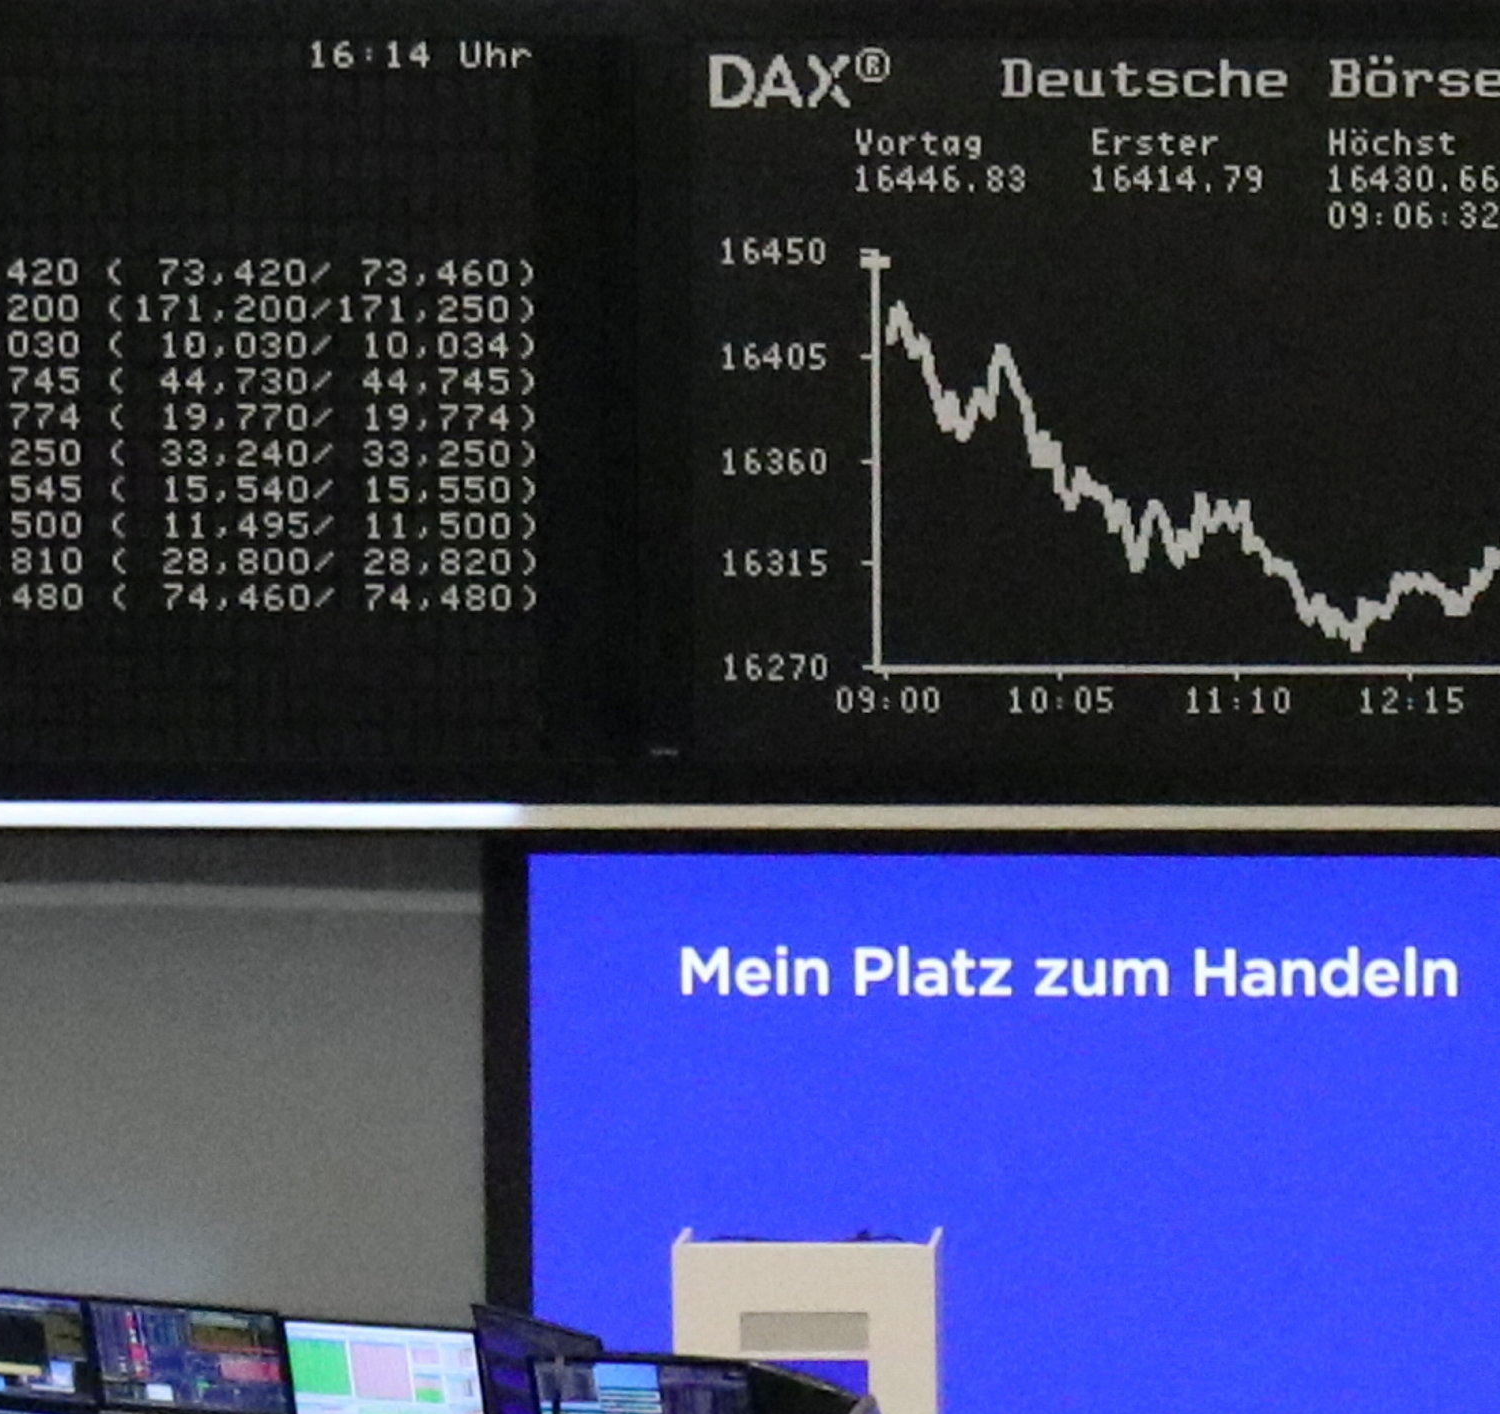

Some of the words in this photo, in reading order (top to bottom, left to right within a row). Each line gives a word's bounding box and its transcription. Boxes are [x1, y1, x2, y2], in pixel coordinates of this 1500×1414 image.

[310, 39, 431, 69] 16:14
[459, 40, 532, 69] Uhr
[1001, 58, 1288, 98] Deutsche
[855, 128, 982, 160] Vortag
[1091, 127, 1219, 156] Erster
[1328, 128, 1455, 157] Höchst
[856, 164, 1026, 193] 16446.83
[1092, 164, 1263, 193] 16414.79
[1329, 164, 1499, 193] 16430.66
[1328, 200, 1499, 230] 09:06:32
[721, 236, 826, 265] 16450
[722, 342, 827, 371] 16405
[723, 447, 827, 476] 16360
[724, 548, 827, 577] 16315
[724, 653, 828, 682] 16270
[836, 686, 940, 714] 09:00
[1009, 685, 1113, 714] 10:05
[1187, 686, 1291, 714] 11:10
[1361, 686, 1464, 715] 12:15
[681, 945, 830, 997] Mein
[854, 945, 1013, 997] Platz
[1034, 958, 1169, 997] zum
[1194, 946, 1458, 998] Handeln
